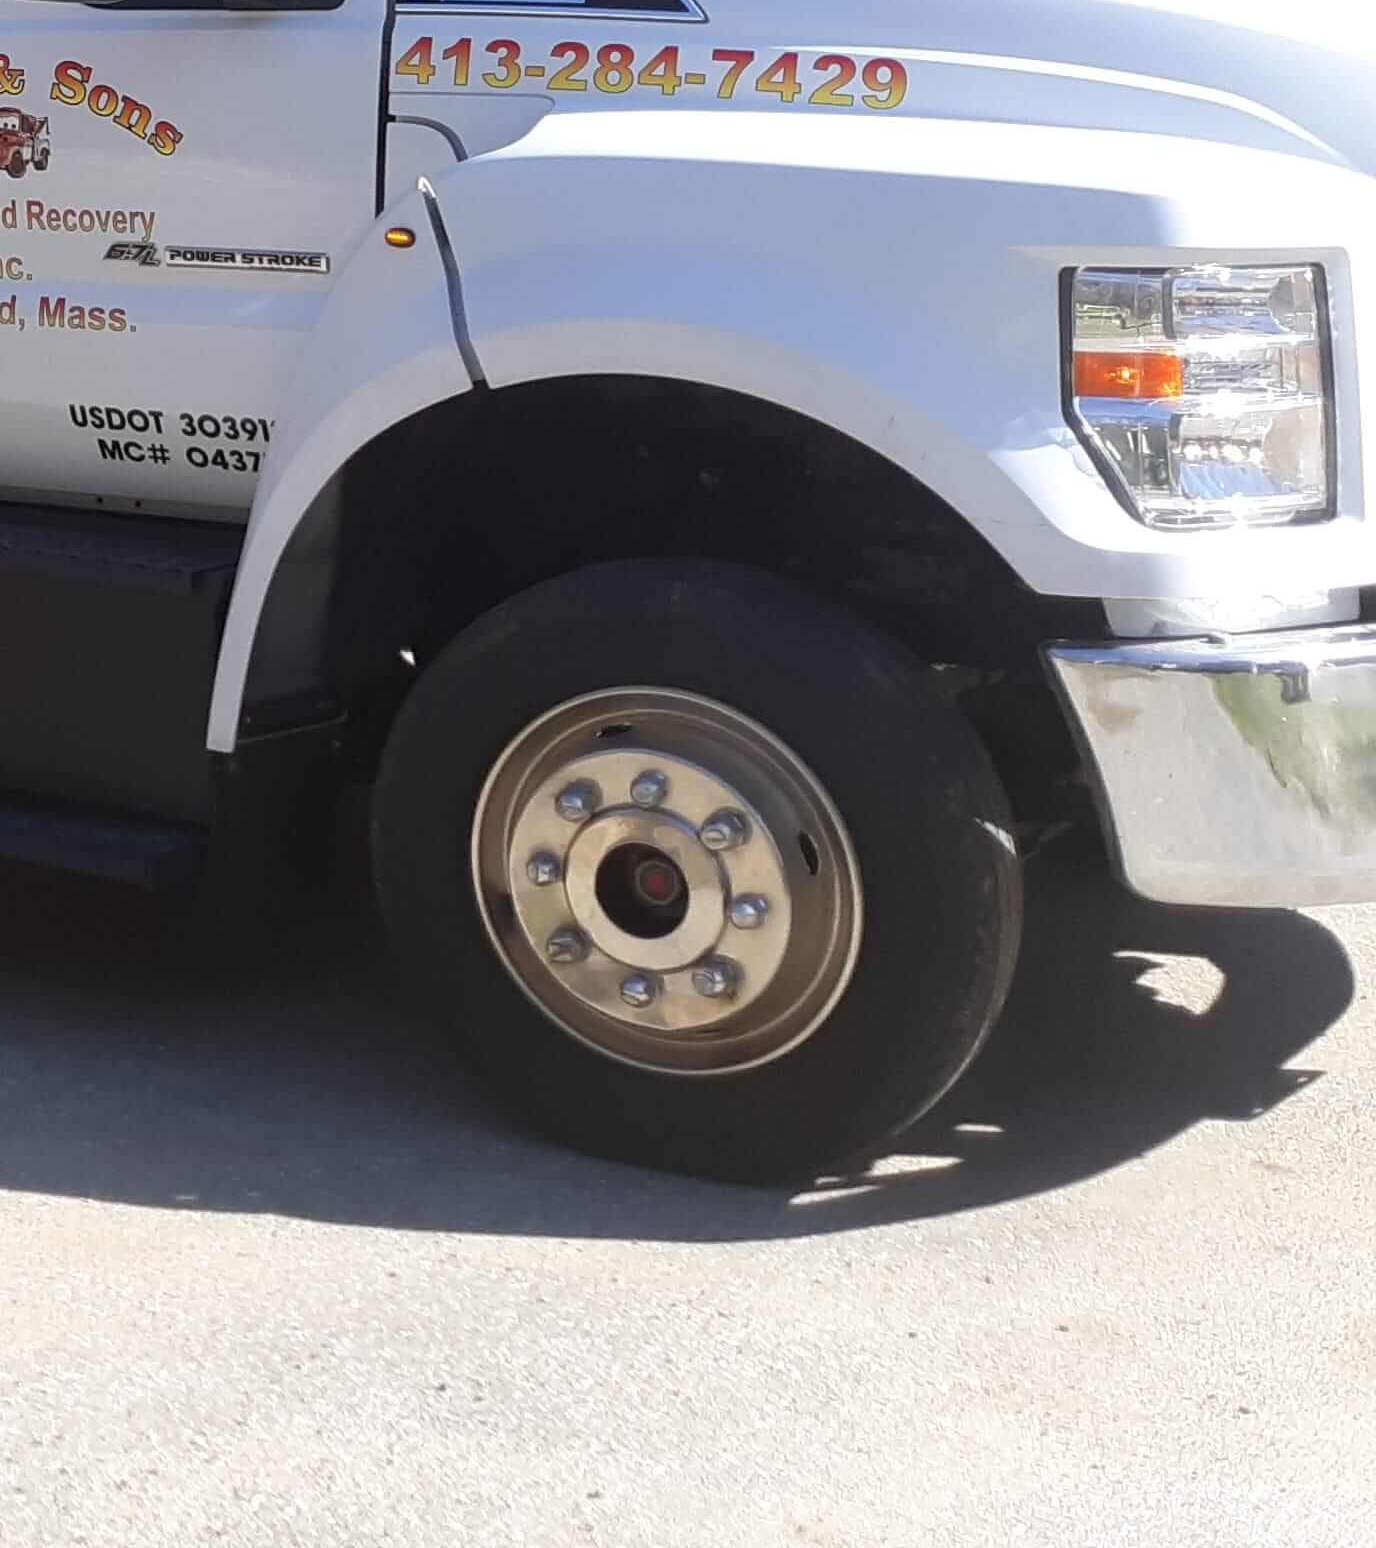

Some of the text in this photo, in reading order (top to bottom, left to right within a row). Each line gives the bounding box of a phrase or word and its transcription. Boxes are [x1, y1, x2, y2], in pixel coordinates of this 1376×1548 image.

[396, 37, 908, 110] 413-284-7429
[50, 60, 184, 157] Sons
[27, 200, 156, 242] Recovery
[169, 250, 236, 263] POWER
[241, 254, 321, 267] STROKE
[38, 297, 137, 333] Mass.
[69, 404, 275, 442] USDOT 30391
[97, 439, 265, 472] MC# 0437
